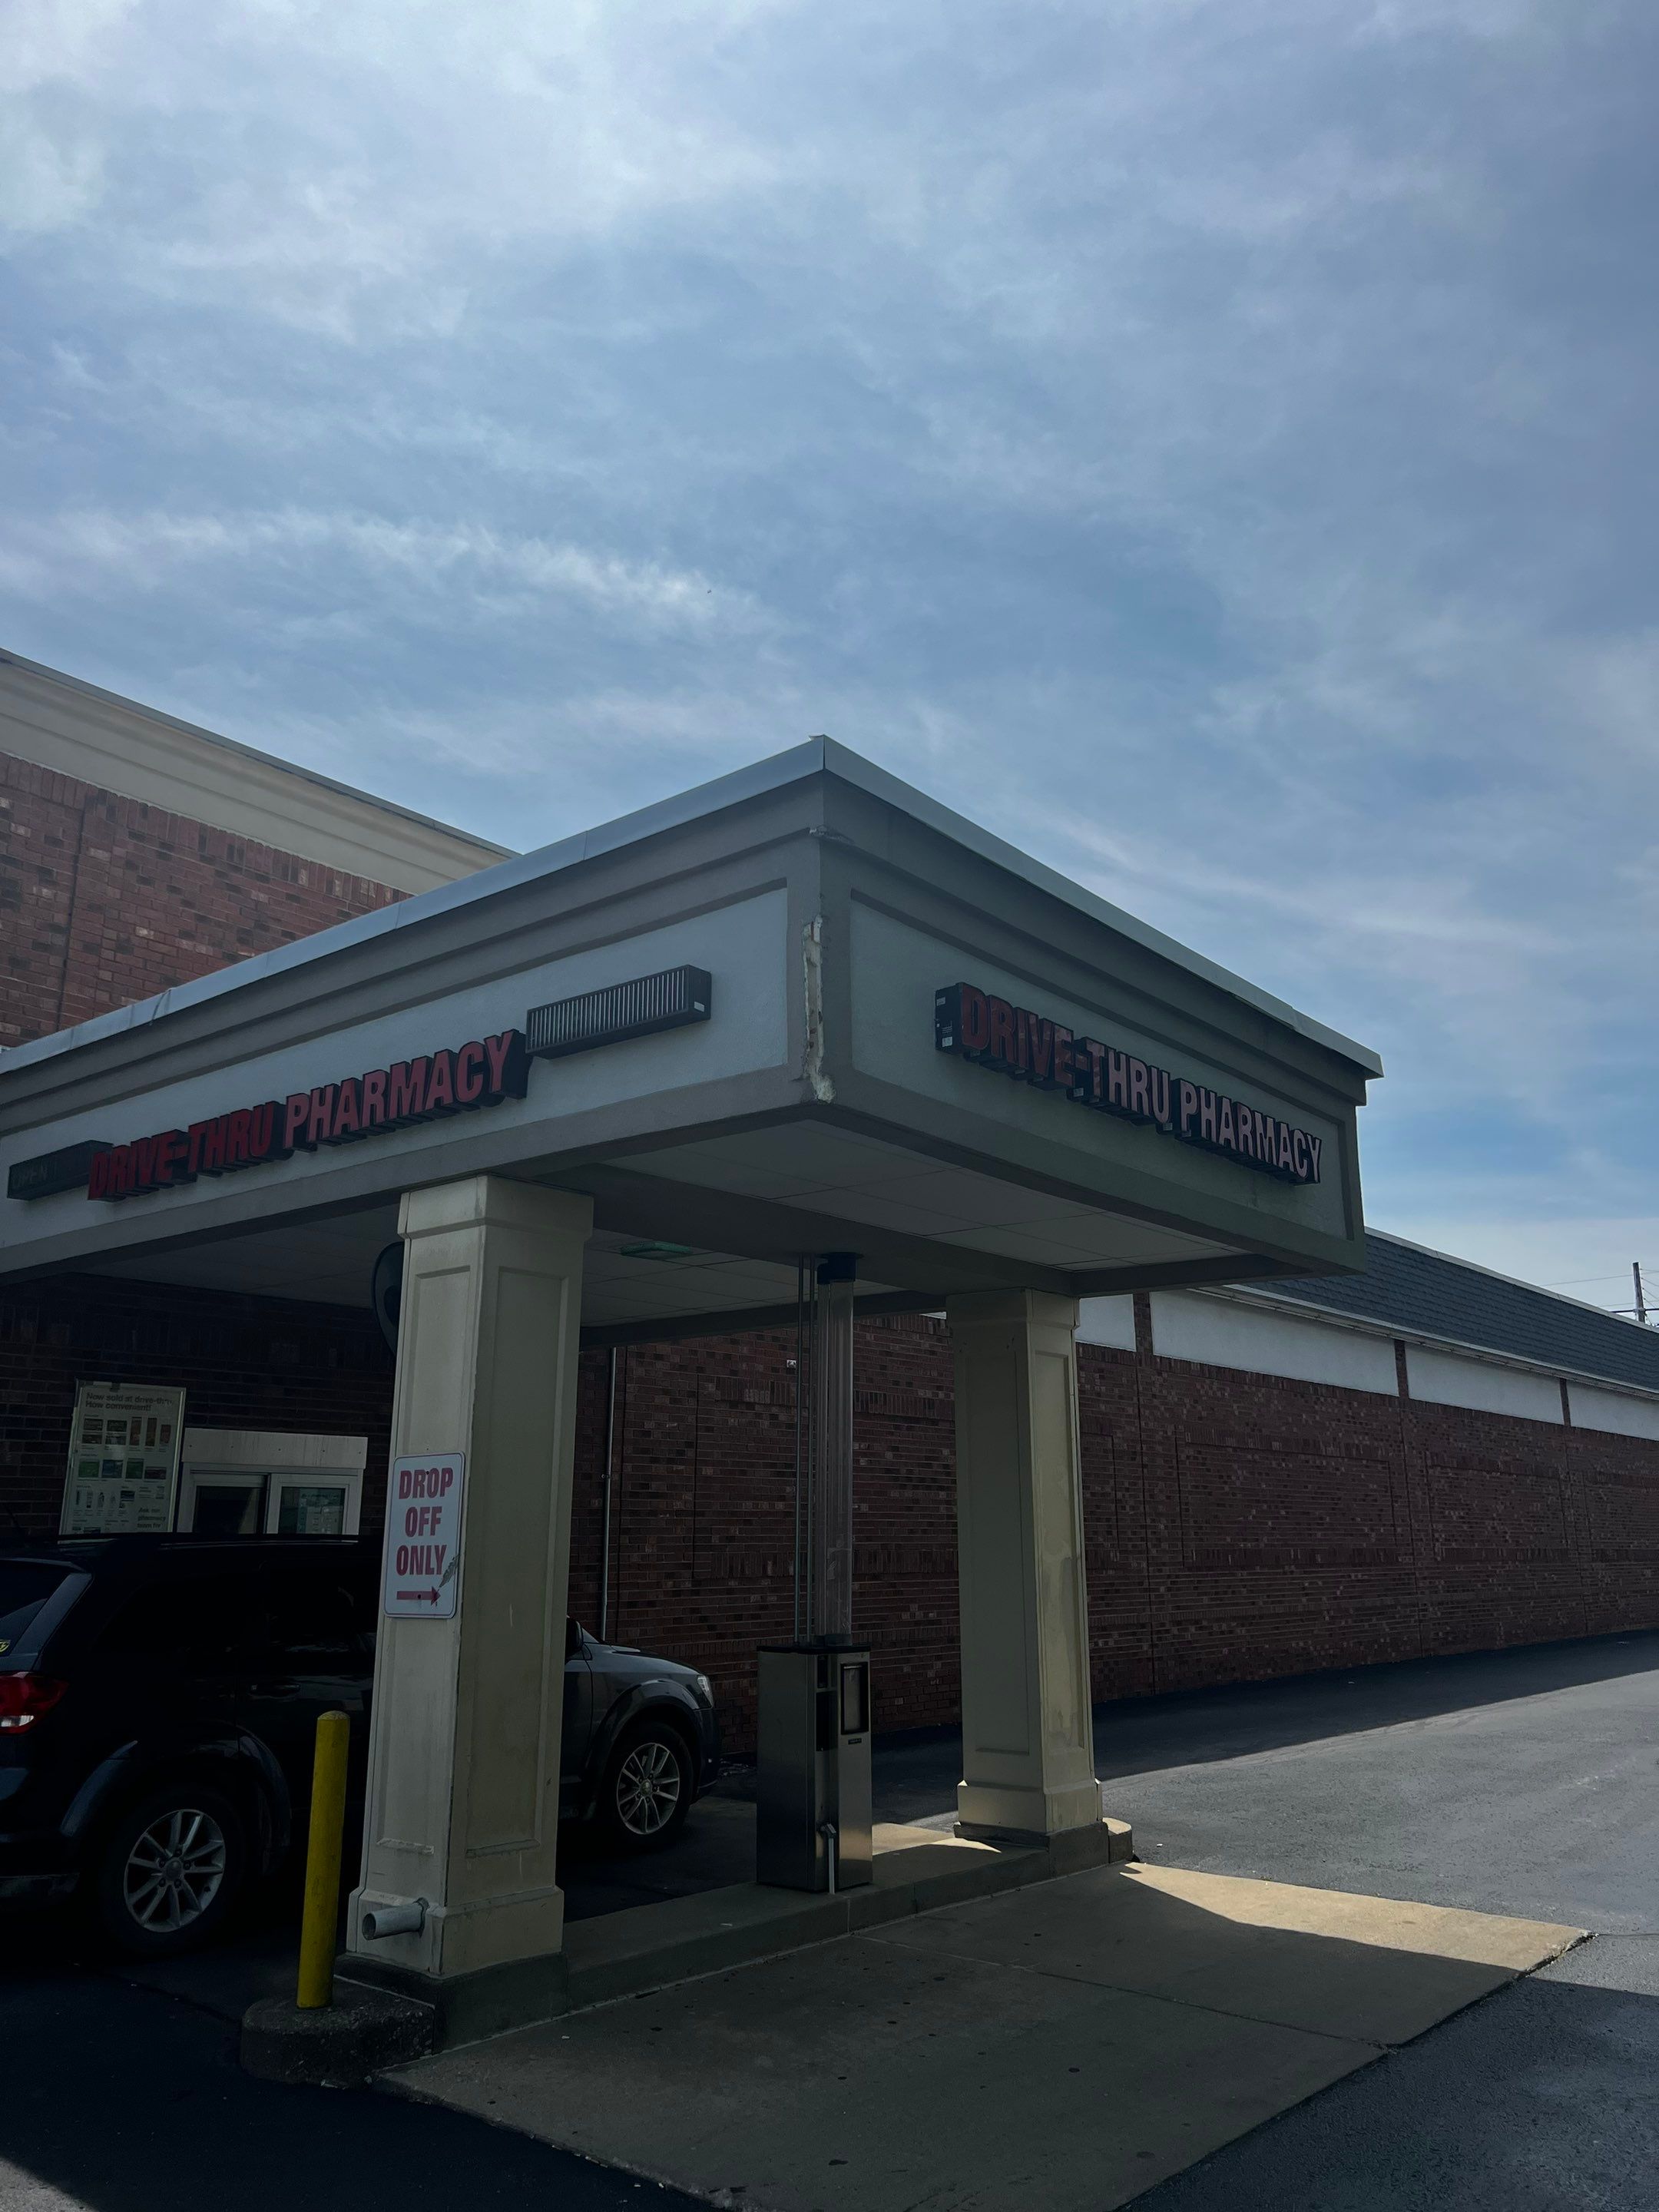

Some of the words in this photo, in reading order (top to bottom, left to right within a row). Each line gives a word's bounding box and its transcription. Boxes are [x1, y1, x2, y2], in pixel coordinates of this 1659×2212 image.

[962, 983, 1171, 1124] DRIVE-THRU
[1179, 1078, 1321, 1184] PHARMACY
[88, 1101, 276, 1200] DRIVE-THRU
[283, 1029, 516, 1151] PHARMACY
[85, 1400, 104, 1409] How
[86, 1392, 104, 1401] Now
[106, 1394, 123, 1402] sold
[398, 1467, 454, 1499] DROP
[405, 1505, 442, 1538] OFF
[396, 1544, 447, 1576] ONLY
